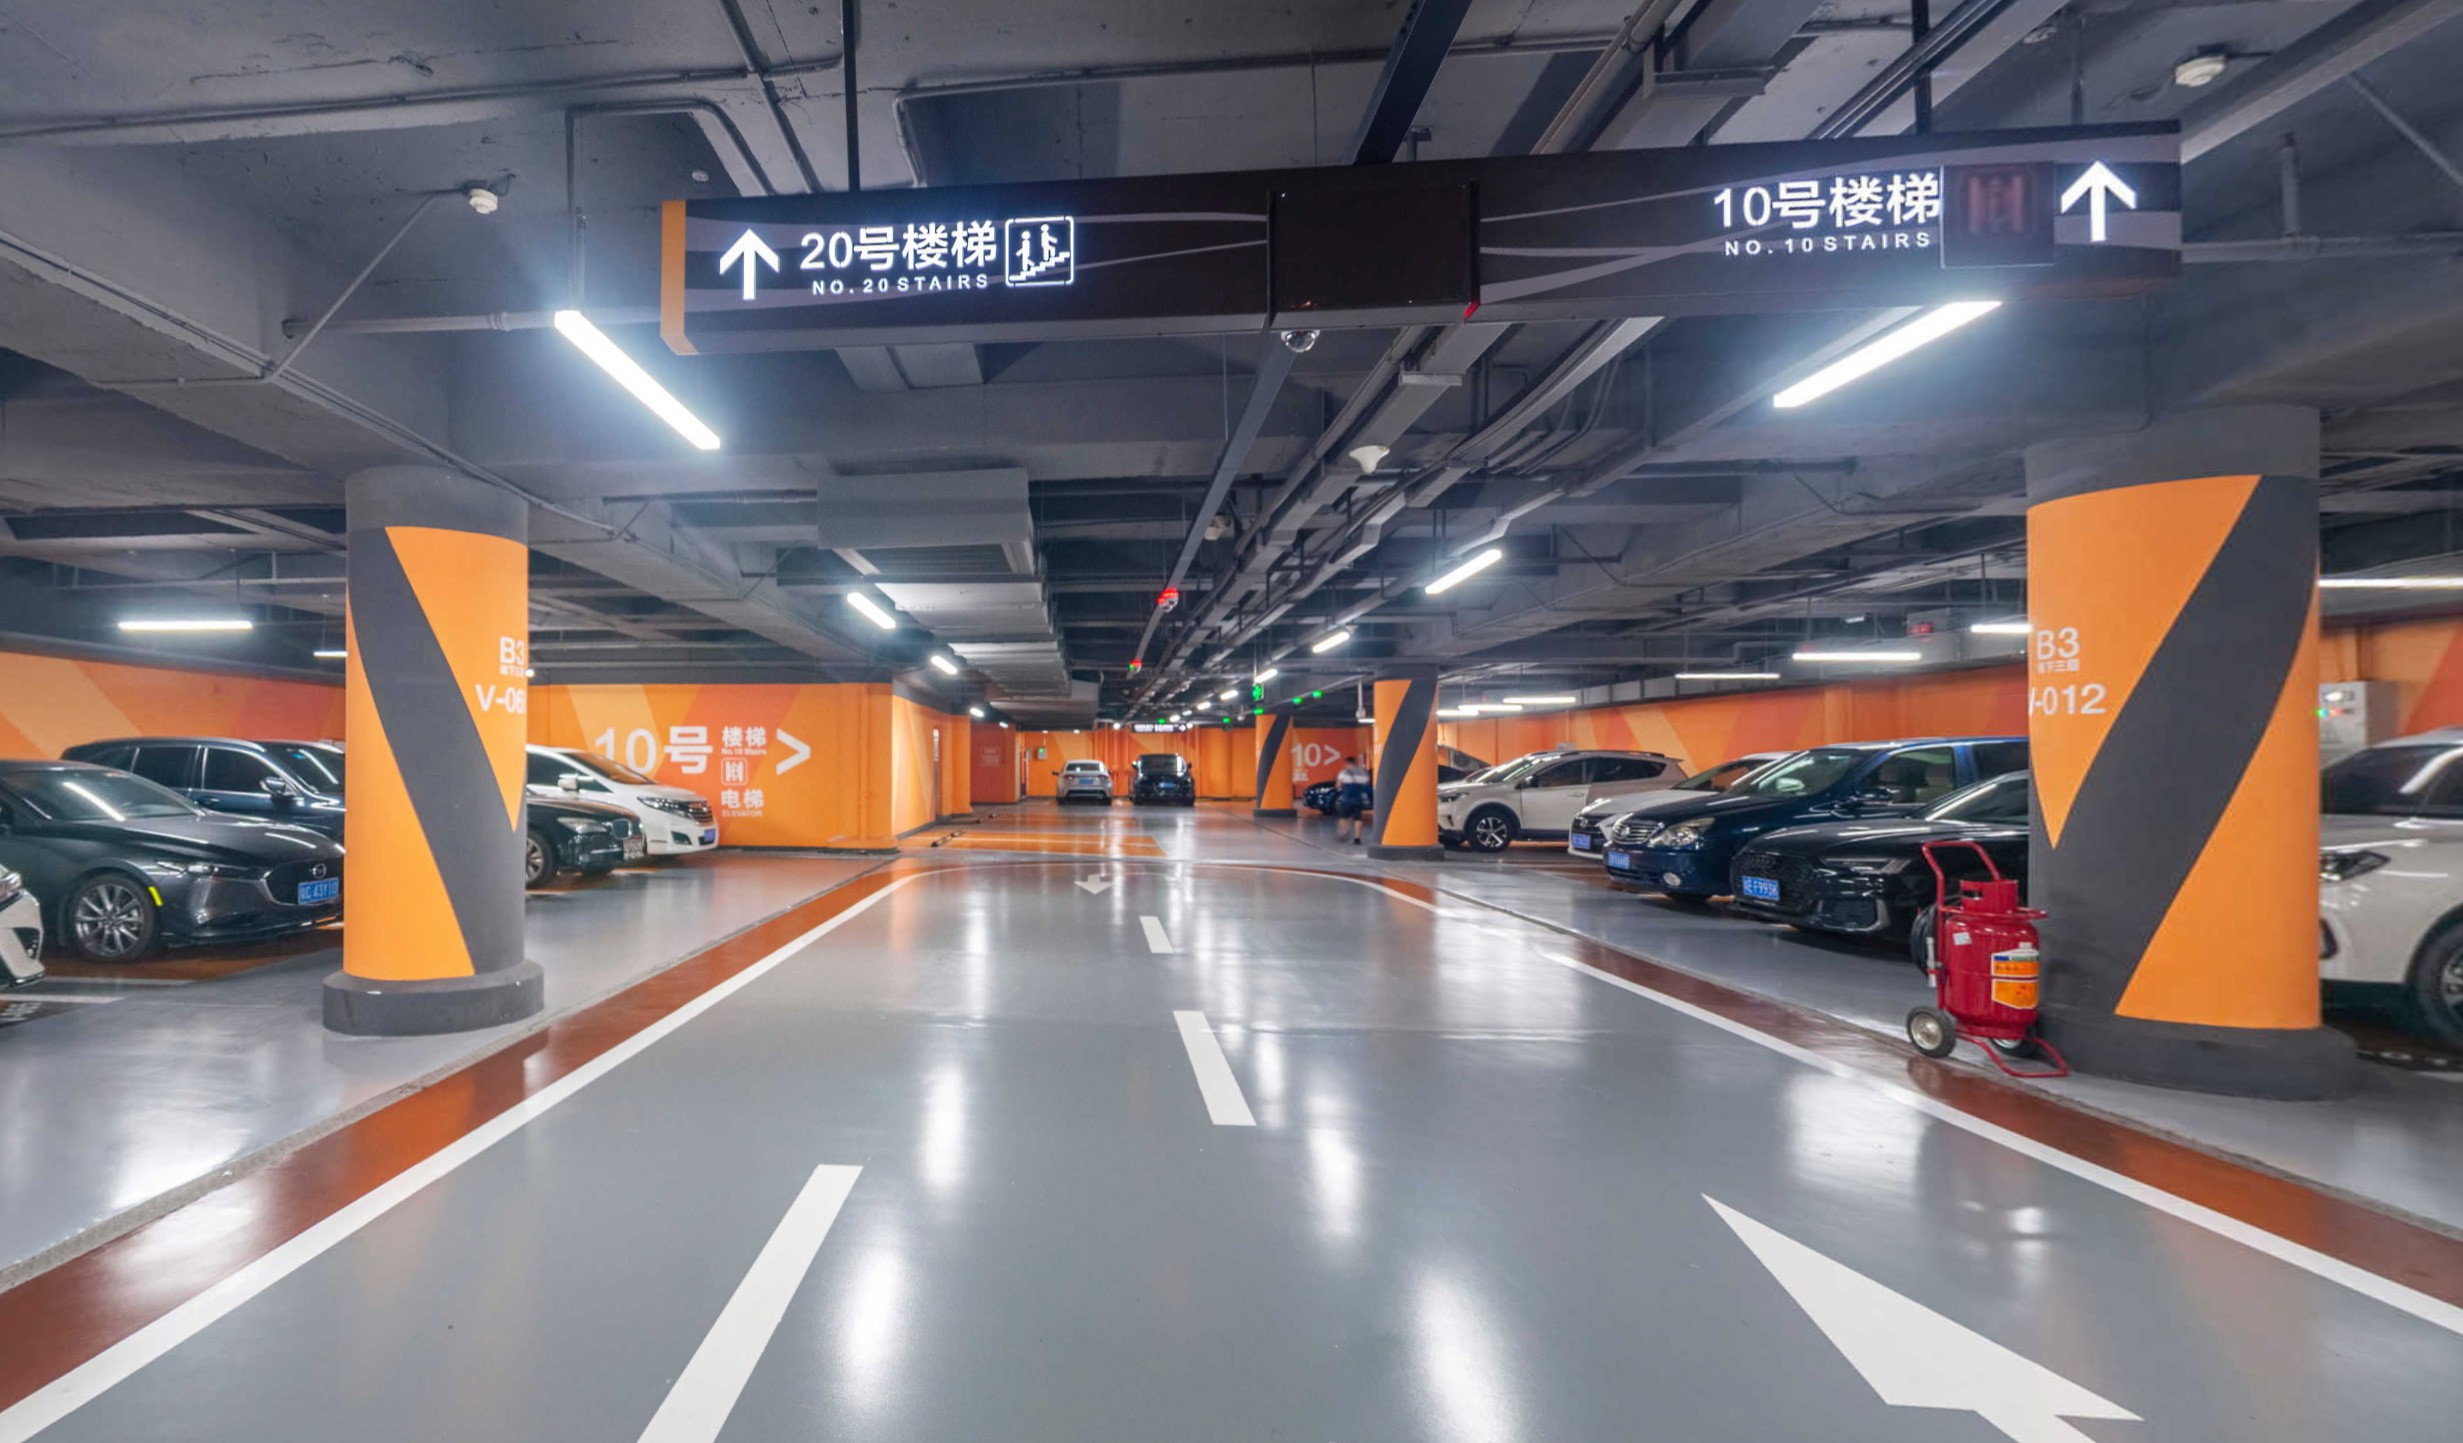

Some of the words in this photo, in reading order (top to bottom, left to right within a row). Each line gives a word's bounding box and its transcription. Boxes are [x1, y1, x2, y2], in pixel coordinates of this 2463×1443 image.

[1713, 172, 1940, 229] 10号楼梯
[799, 220, 996, 271] 20号楼梯
[1823, 231, 1931, 251] STAIRS
[897, 273, 988, 292] STAIRS
[499, 636, 526, 666] B3
[2036, 627, 2080, 660] B3
[722, 726, 767, 747] 楼梯
[595, 726, 713, 775] 10号
[1291, 743, 1322, 768] 10
[721, 789, 764, 808] 电梯
